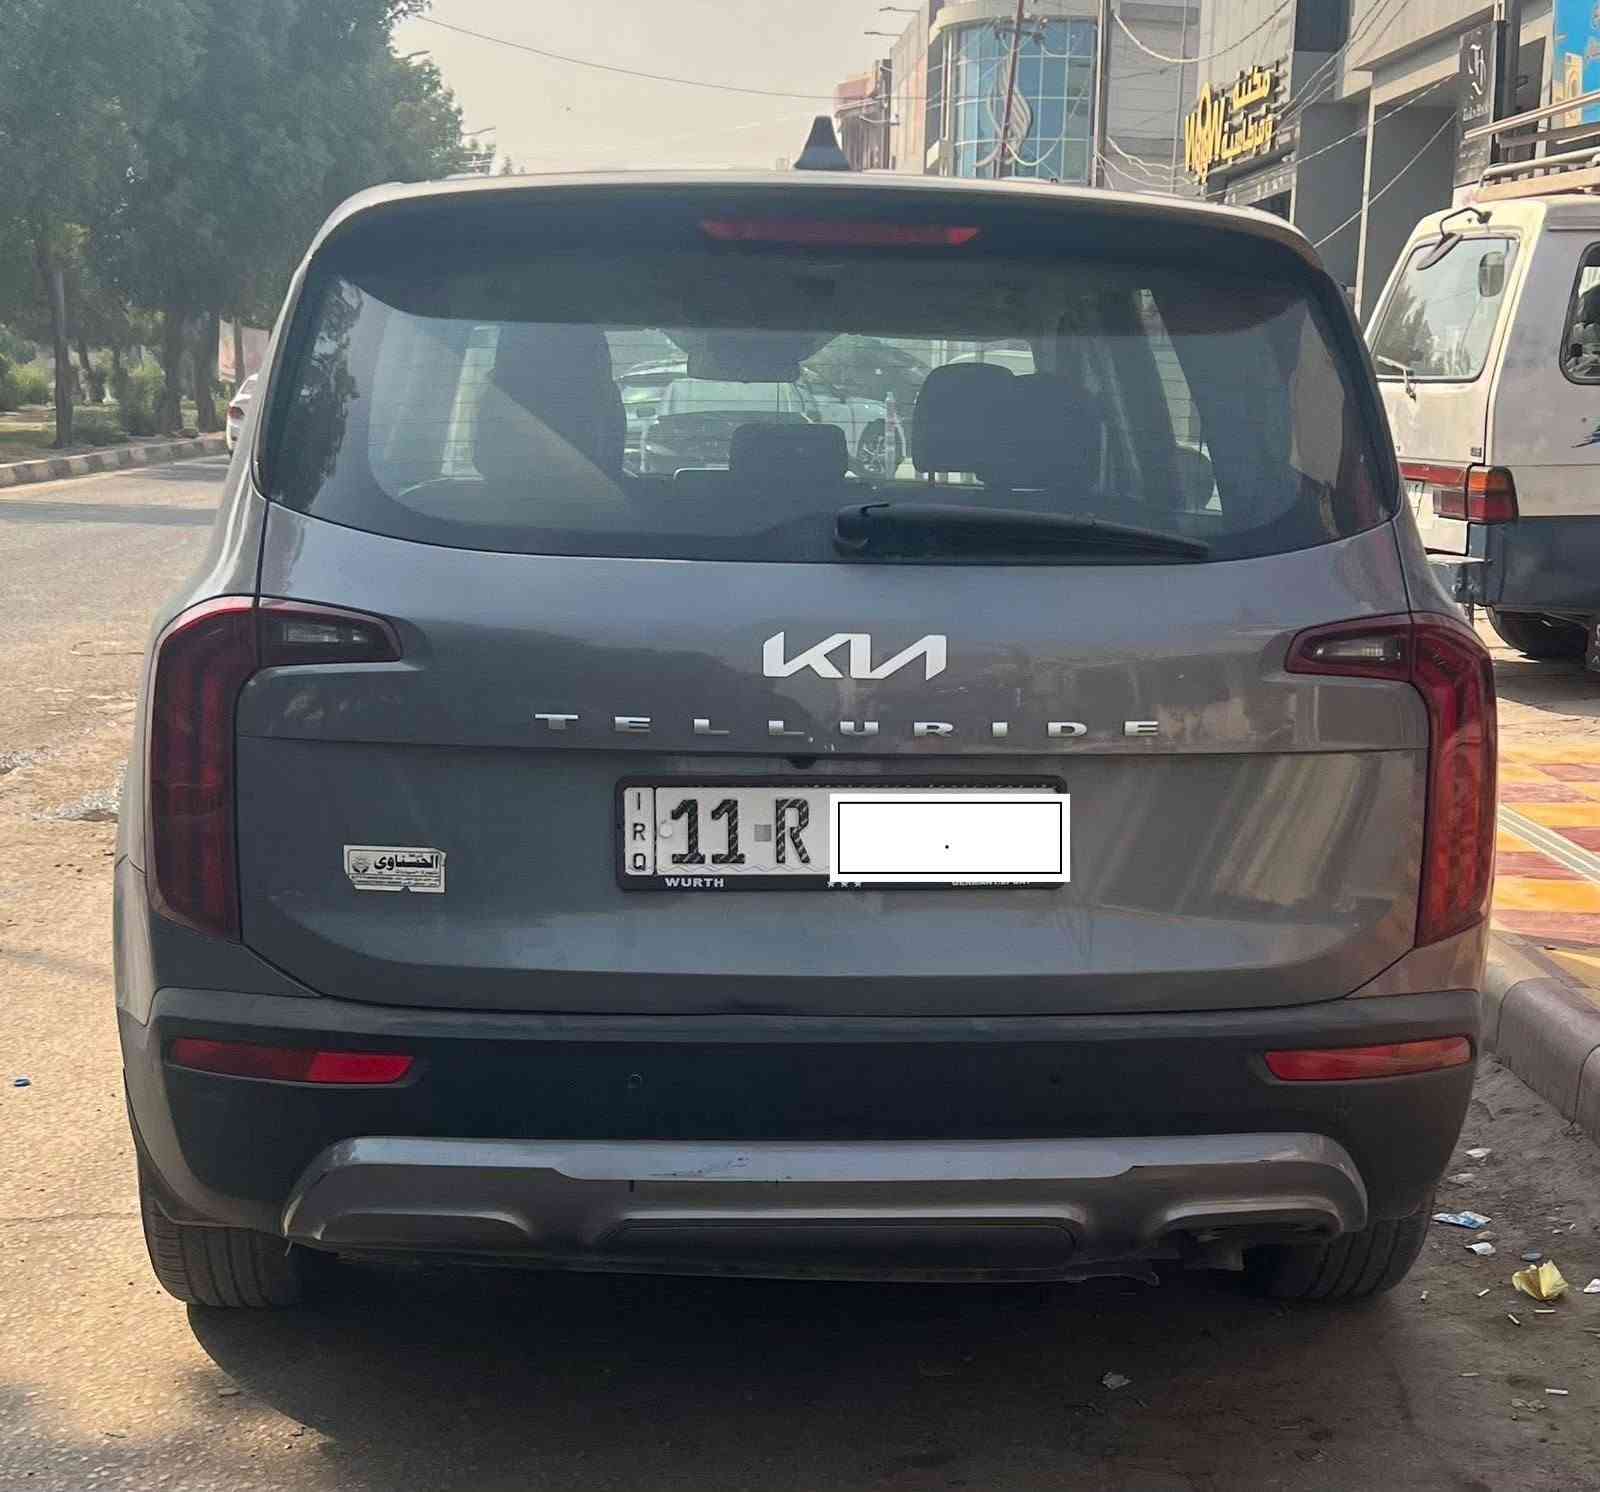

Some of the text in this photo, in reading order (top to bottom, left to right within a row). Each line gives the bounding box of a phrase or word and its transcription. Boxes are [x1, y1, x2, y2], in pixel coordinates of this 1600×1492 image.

[763, 632, 947, 681] KIA
[535, 713, 1160, 738] TELLURIDE
[632, 792, 647, 871] IRQ
[671, 799, 811, 864] 11 R
[664, 877, 725, 888] WURTH
